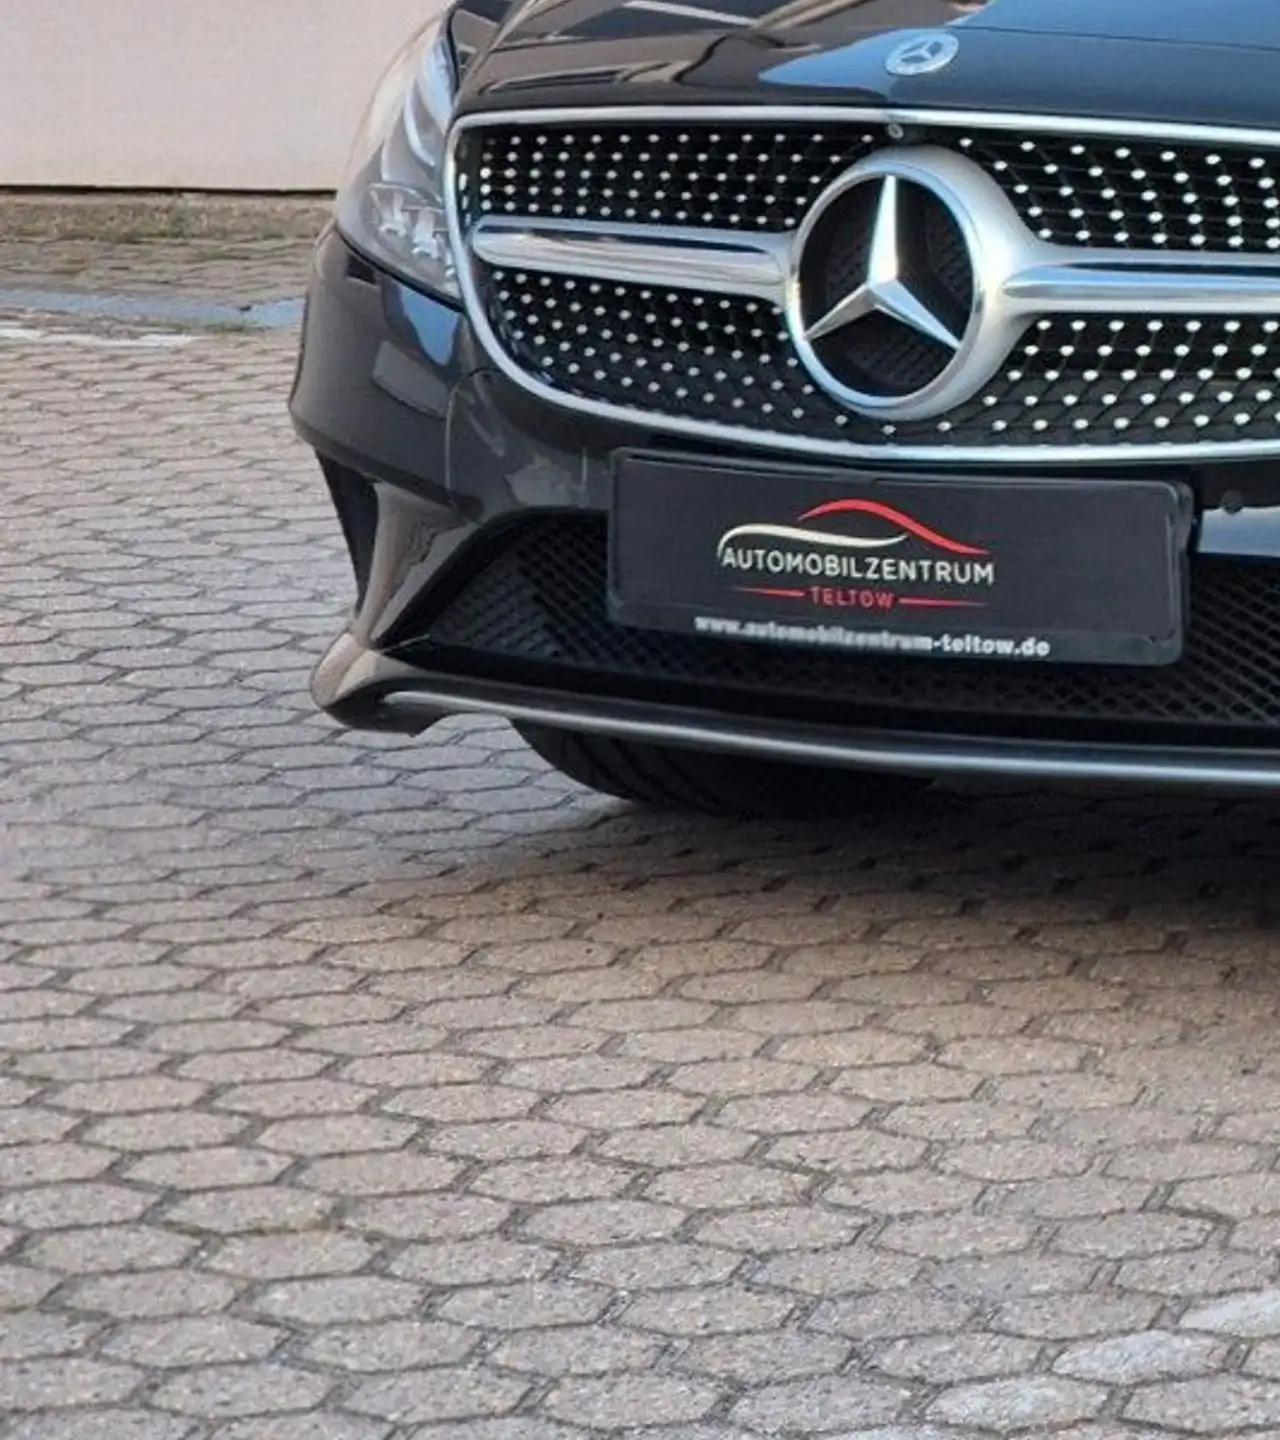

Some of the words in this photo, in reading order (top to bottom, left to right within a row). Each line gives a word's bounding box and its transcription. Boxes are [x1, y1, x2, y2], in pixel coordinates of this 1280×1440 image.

[721, 547, 994, 586] AUTOMOBILZENTRUM
[808, 586, 895, 609] TELTOW
[694, 616, 1052, 657] www.automobilzentrum-teltow.de
